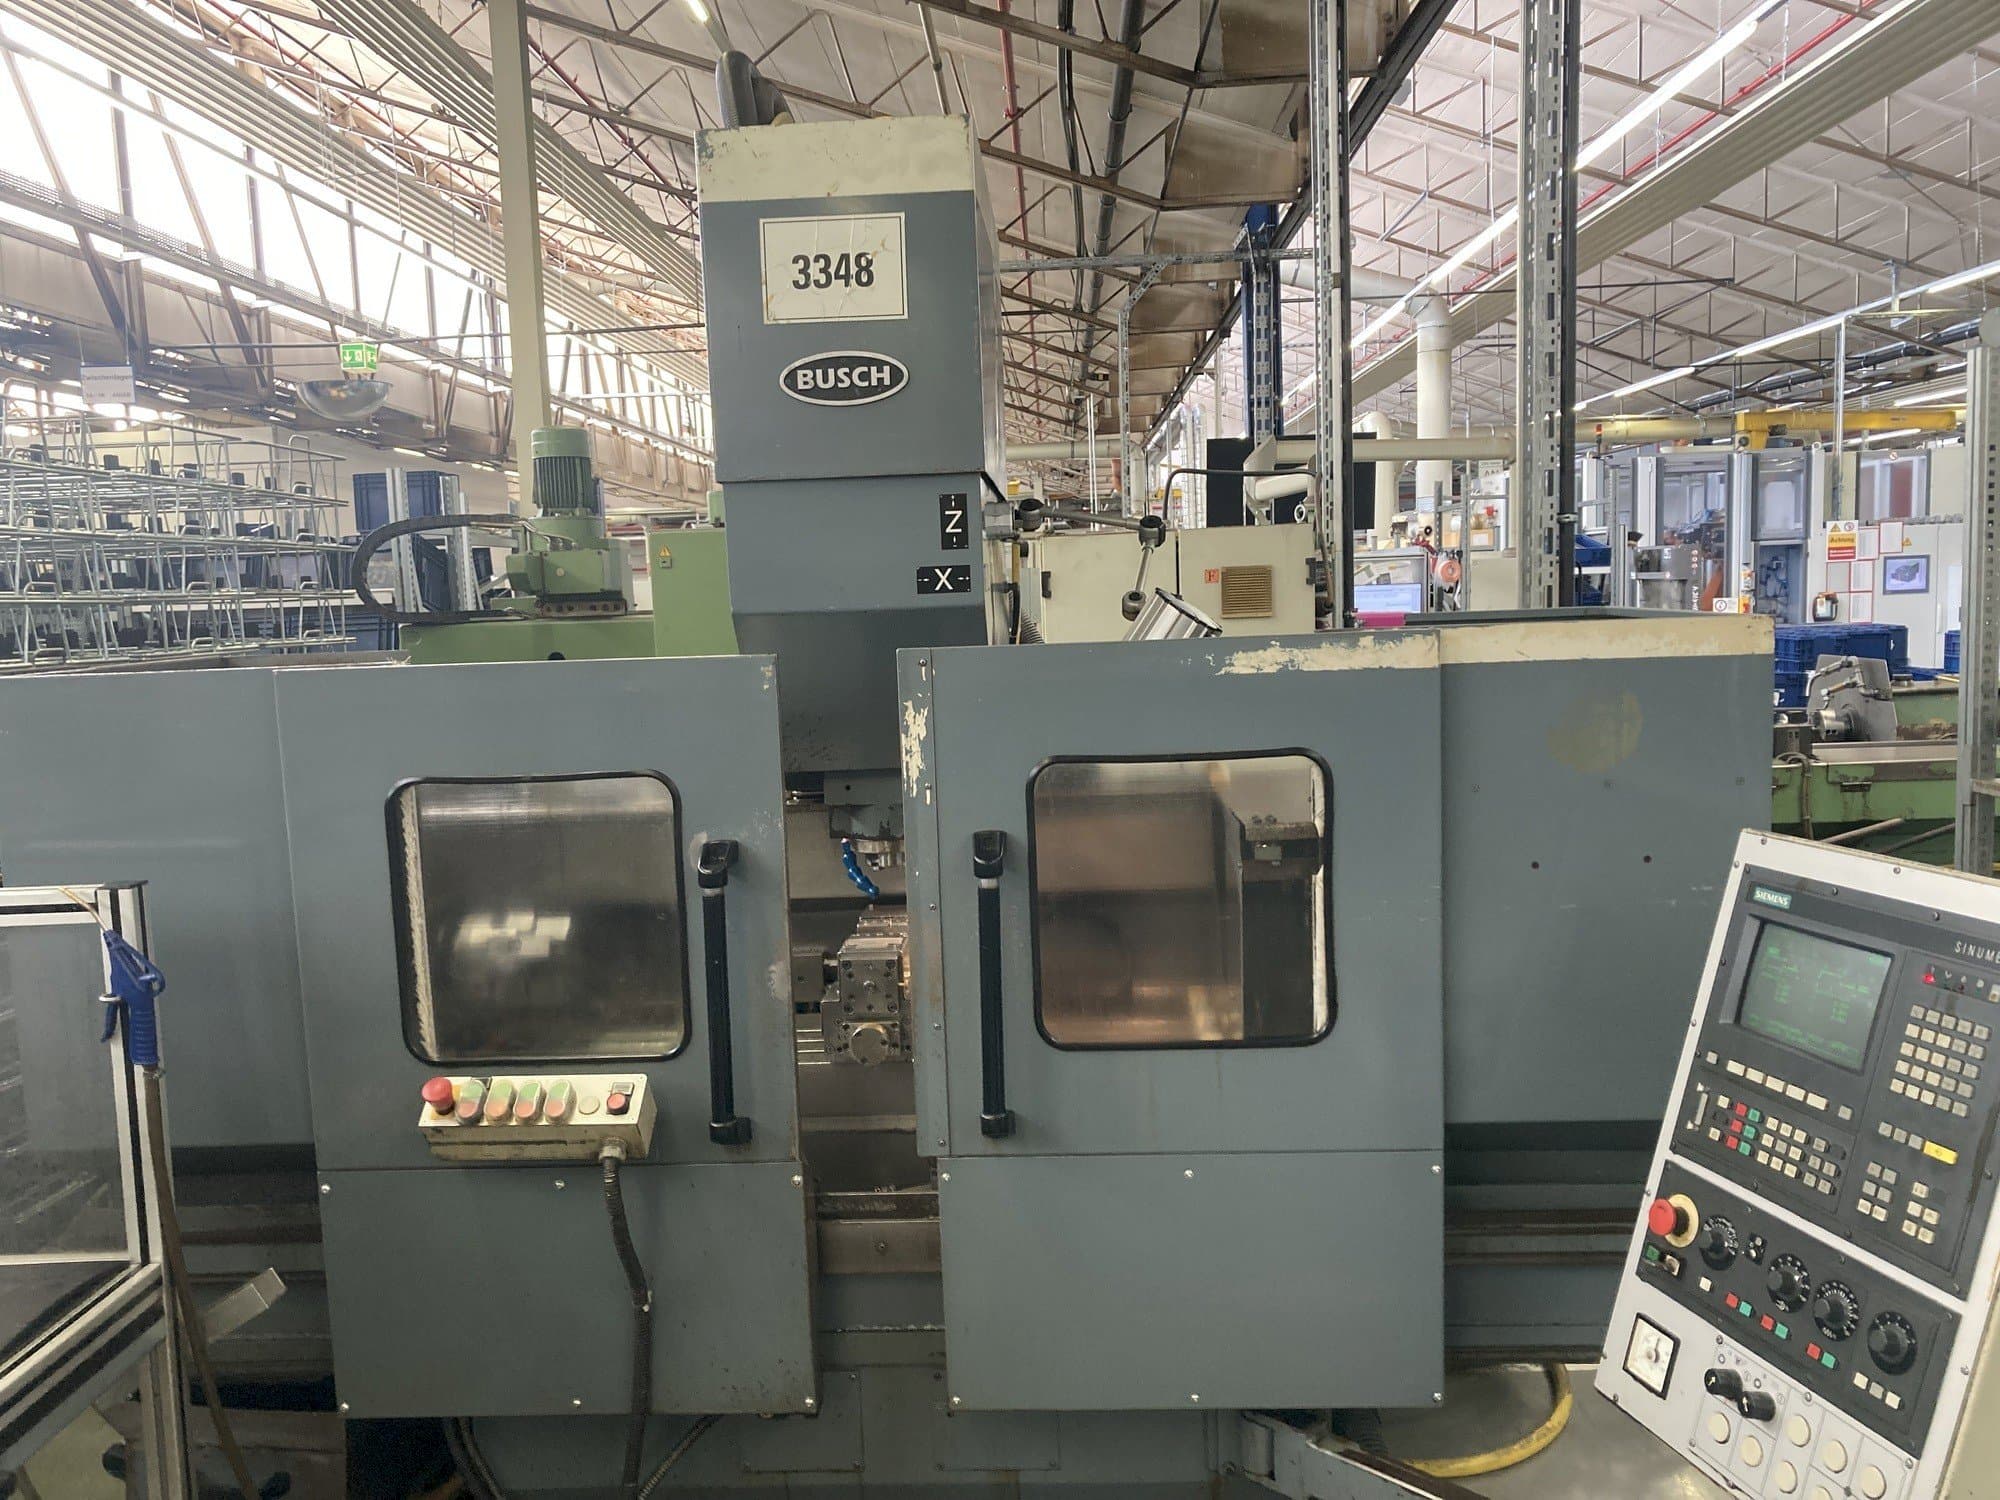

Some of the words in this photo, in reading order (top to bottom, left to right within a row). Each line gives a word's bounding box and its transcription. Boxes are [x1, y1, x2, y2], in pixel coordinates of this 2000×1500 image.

[791, 252, 874, 289] 3348
[796, 366, 891, 389] BUSCH
[944, 510, 962, 533] Z
[1755, 891, 1788, 906] SIEMENS
